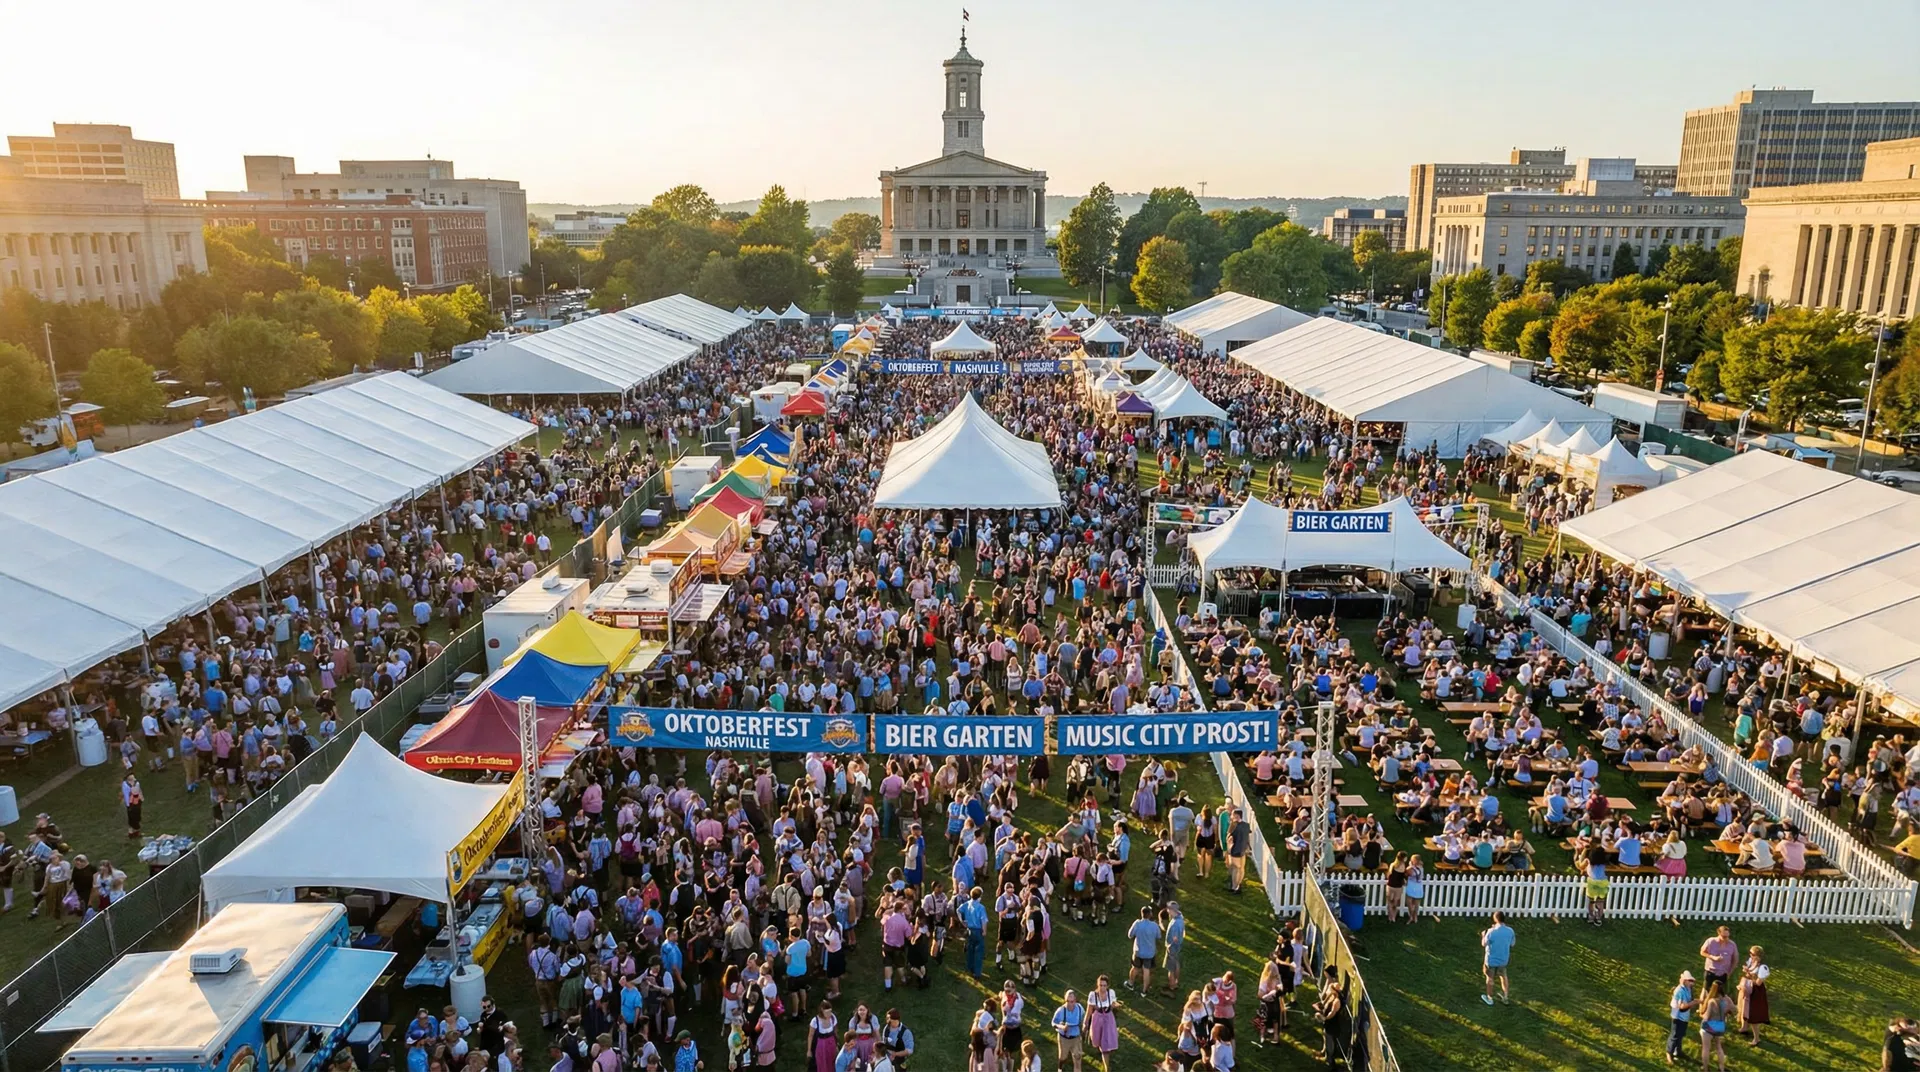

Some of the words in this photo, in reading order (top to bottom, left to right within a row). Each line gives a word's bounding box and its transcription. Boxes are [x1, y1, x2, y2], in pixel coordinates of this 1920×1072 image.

[955, 363, 1000, 374] NASHVILLE
[1296, 515, 1328, 529] BIER
[1331, 515, 1384, 530] GARTEN
[664, 713, 811, 738] OKTOBERFEST
[1066, 724, 1135, 747] MUSIC
[1140, 723, 1188, 746] CITY
[1193, 720, 1270, 744] PROST!
[705, 735, 770, 750] NASHVILLE
[885, 724, 937, 748] BIER
[943, 725, 1032, 748] GARTEN
